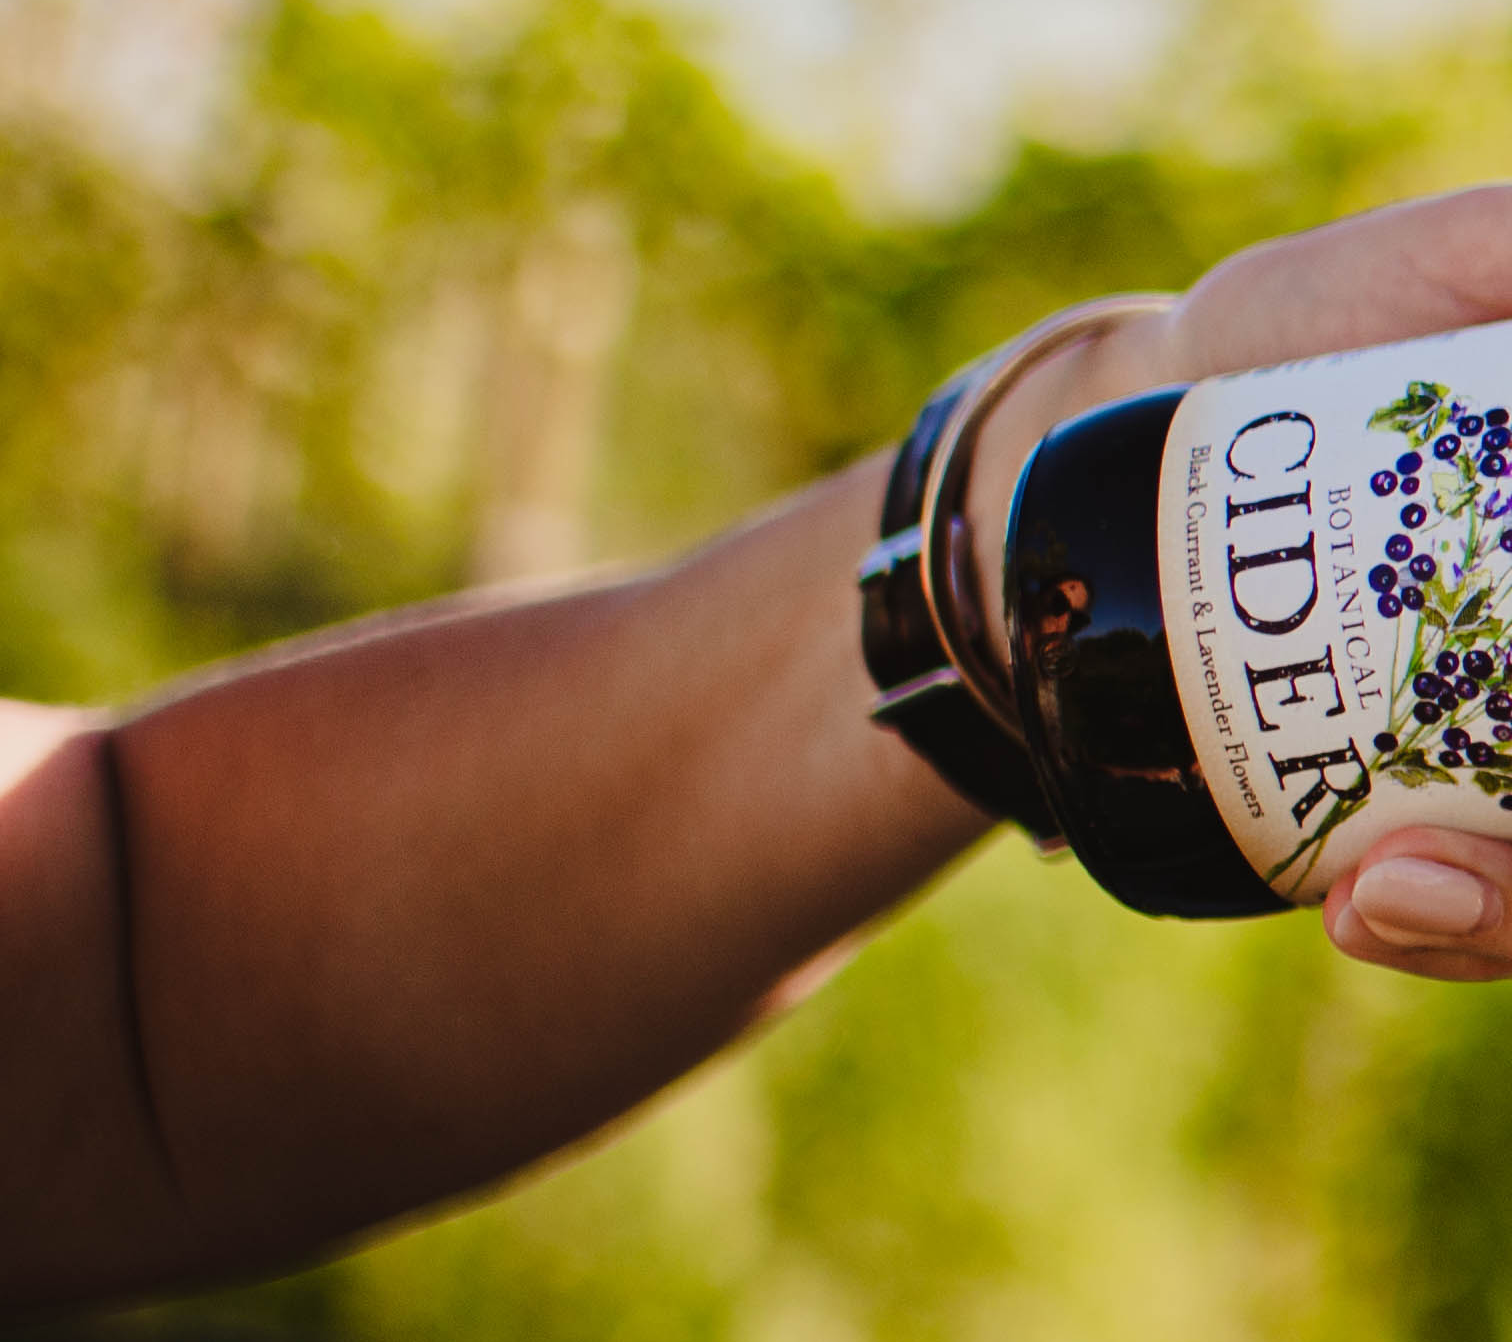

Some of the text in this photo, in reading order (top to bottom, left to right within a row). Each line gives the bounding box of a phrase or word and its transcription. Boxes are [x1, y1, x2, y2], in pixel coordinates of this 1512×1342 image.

[1184, 443, 1266, 820] Black Currant & Lavender Flowers
[1225, 410, 1372, 829] CIDER
[1327, 484, 1383, 712] BOTANICAL
